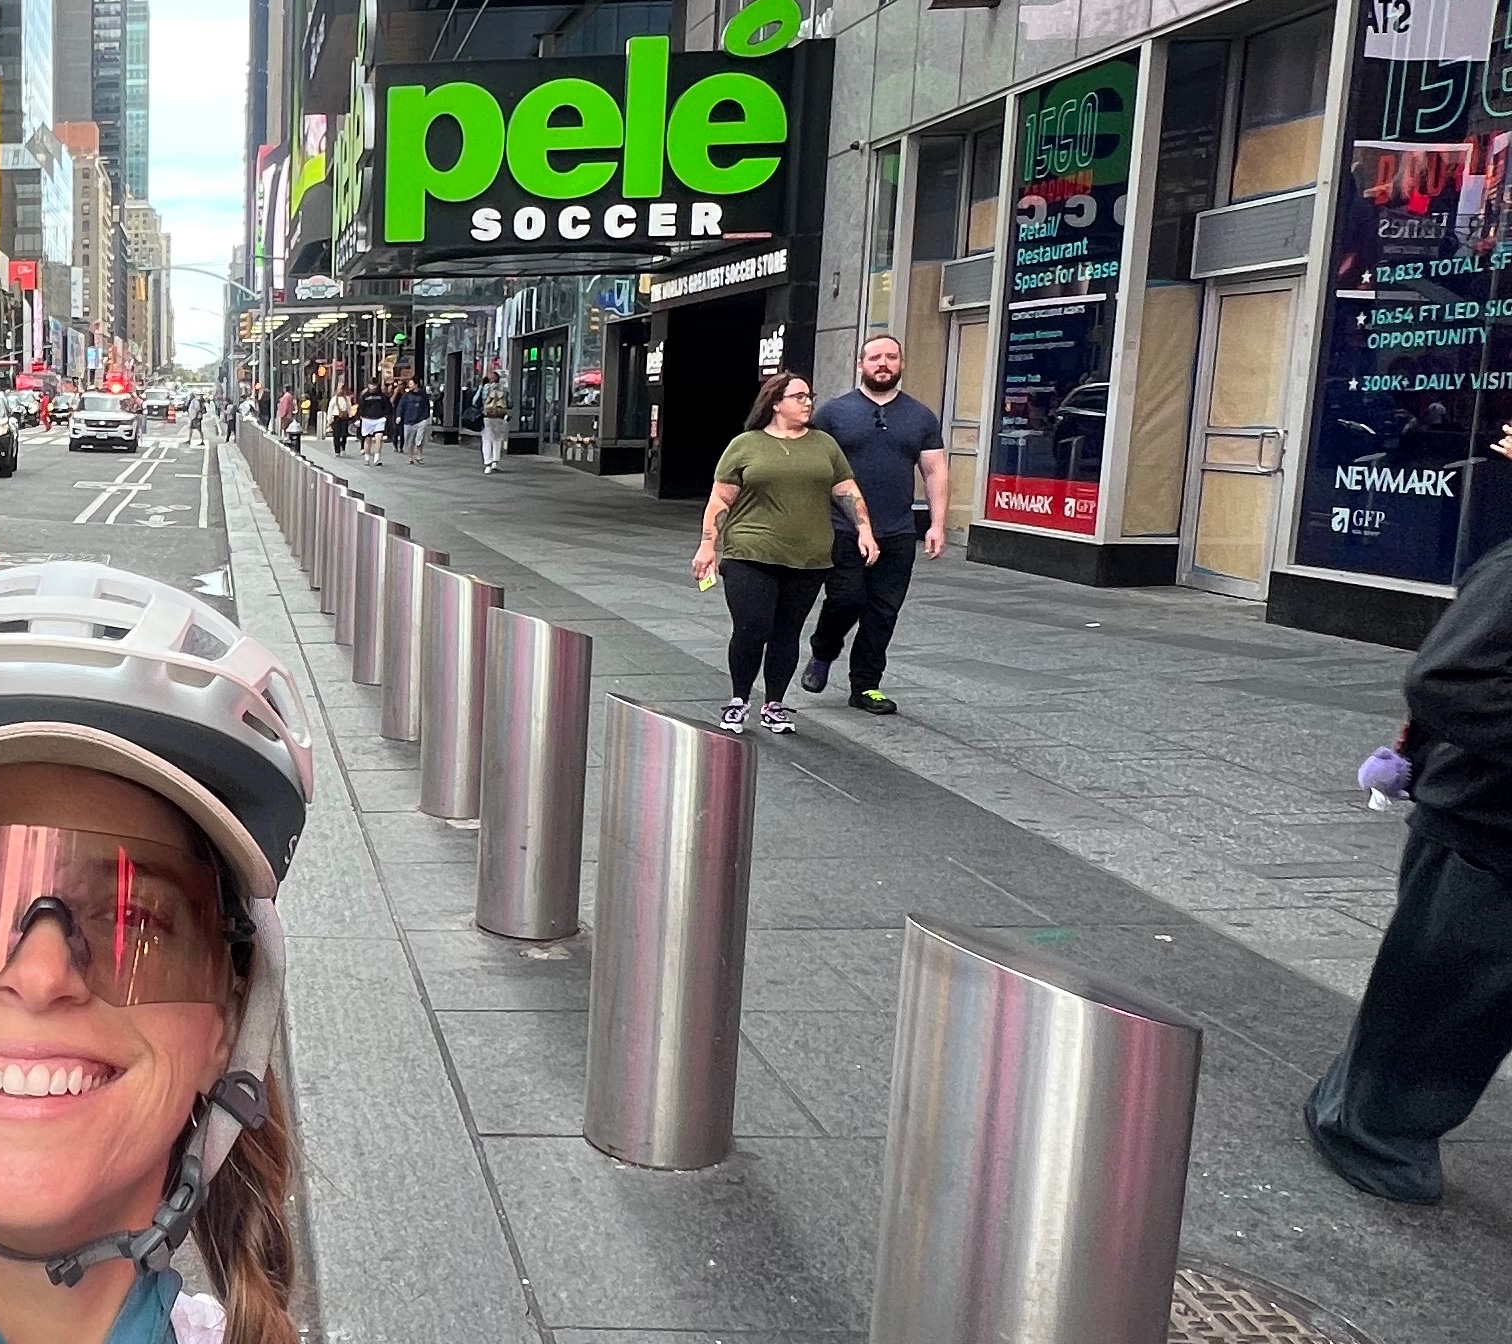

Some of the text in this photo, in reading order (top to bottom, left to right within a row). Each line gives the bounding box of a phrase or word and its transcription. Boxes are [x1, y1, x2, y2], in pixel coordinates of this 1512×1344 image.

[469, 201, 724, 242] SOCCER
[1018, 212, 1062, 243] Retail/
[724, 257, 757, 285] SOCCER
[756, 248, 788, 278] STORE
[1016, 236, 1089, 267] Restaurant
[1014, 260, 1119, 294] Space for Lease
[1375, 252, 1512, 285] 12,832 TOTAL SF
[1370, 306, 1415, 326] 16x54
[1418, 304, 1441, 322] FT
[1444, 301, 1480, 321] LED
[1367, 327, 1487, 349] OPPORTUNITY
[1360, 373, 1410, 392] 300K+
[1414, 372, 1466, 391] DAILY
[1334, 464, 1457, 497] NEWMARK
[994, 489, 1096, 515] NEWMARK GFP
[1352, 509, 1386, 528] GFP
